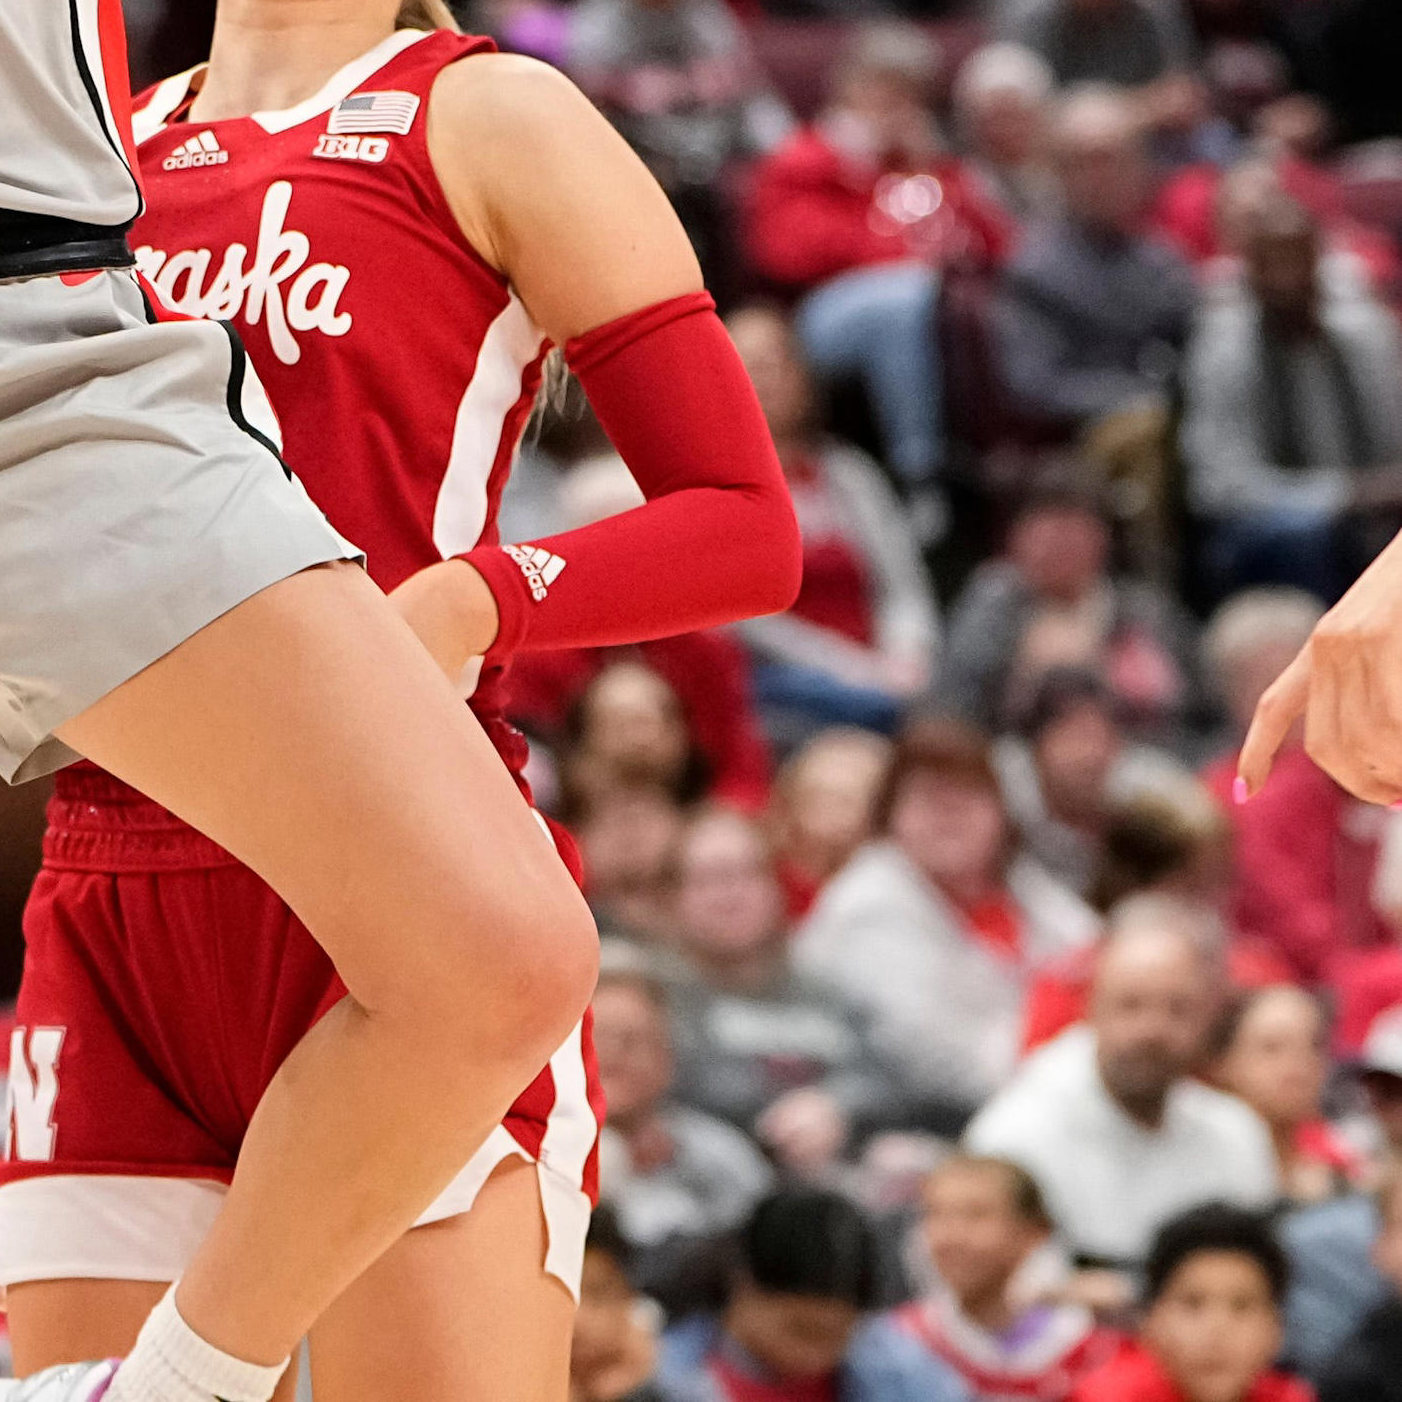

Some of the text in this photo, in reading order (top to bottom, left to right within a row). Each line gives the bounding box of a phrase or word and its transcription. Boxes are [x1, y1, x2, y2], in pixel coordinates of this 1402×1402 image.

[162, 149, 229, 171] adidas
[133, 180, 353, 365] raska
[4, 1025, 67, 1162] N
